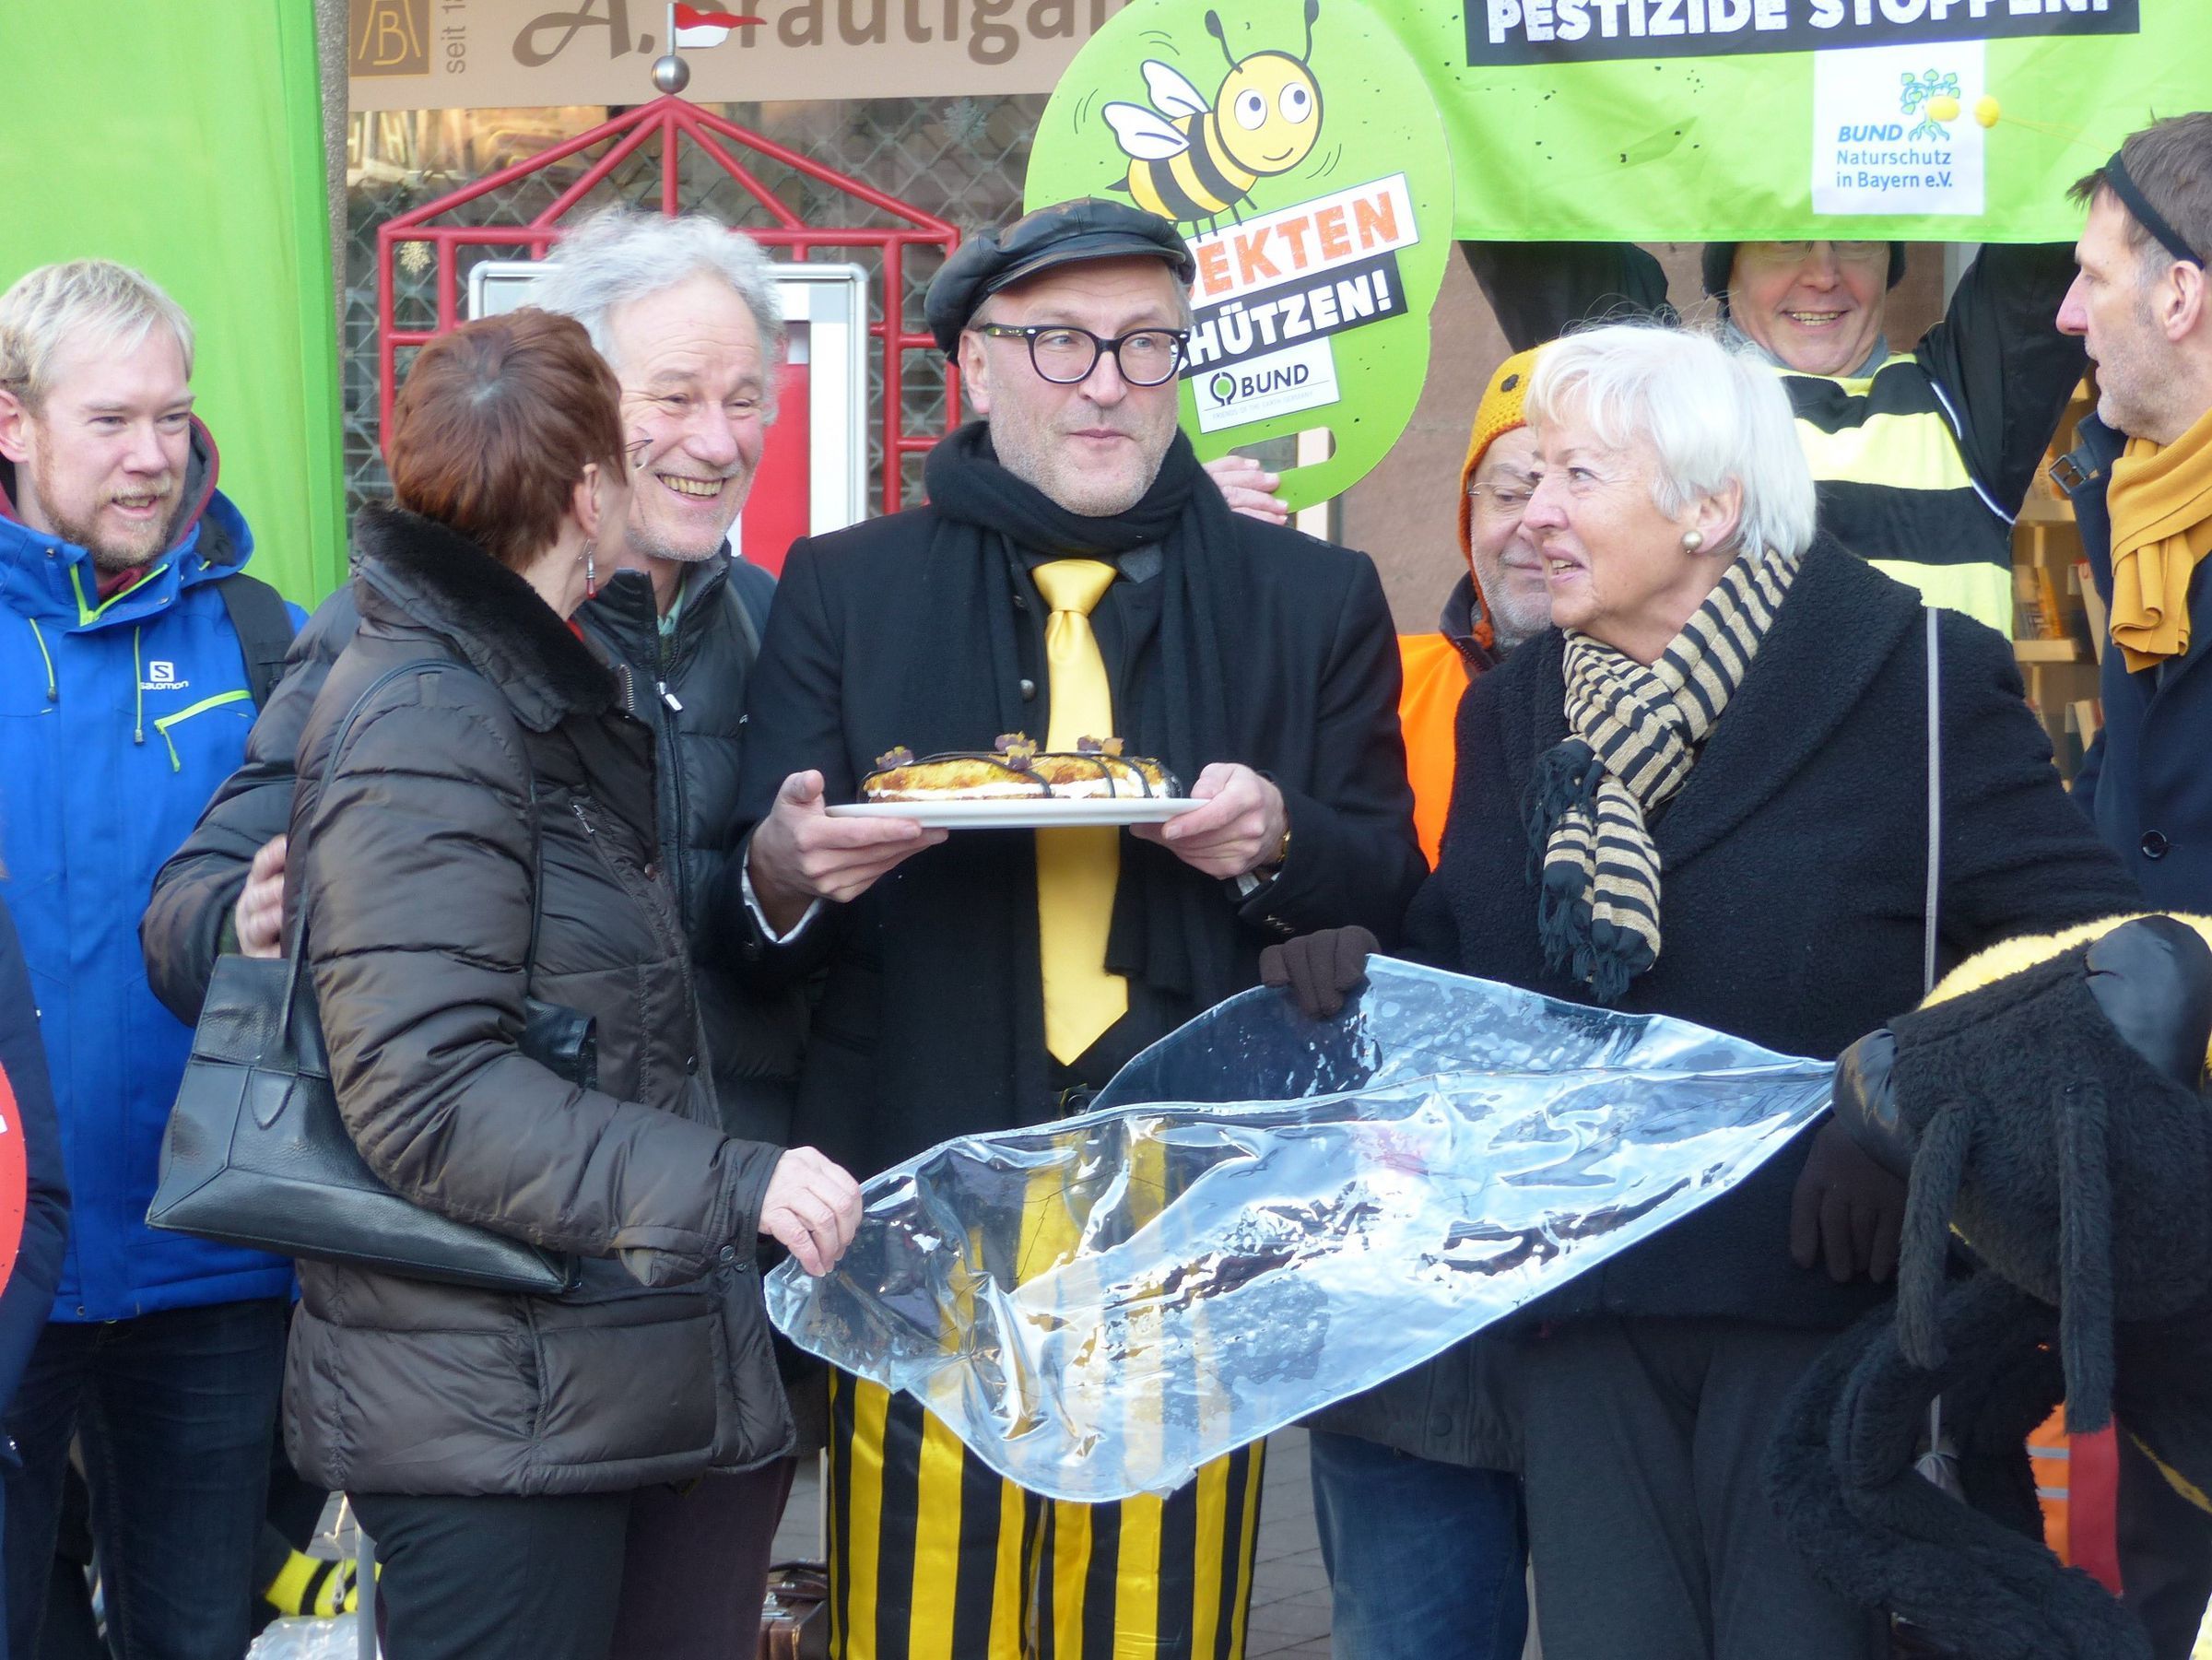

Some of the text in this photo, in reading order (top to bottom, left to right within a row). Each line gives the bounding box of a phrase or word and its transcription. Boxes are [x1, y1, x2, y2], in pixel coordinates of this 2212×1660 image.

[1487, 0, 2109, 43] PESTIZIDE STOP
[1838, 124, 1903, 142] BUND
[1837, 148, 1952, 165] Naturschutz
[1837, 171, 1953, 192] in Bayern e.V.
[1190, 191, 1399, 300] EKTEN
[1241, 363, 1310, 398] BUND
